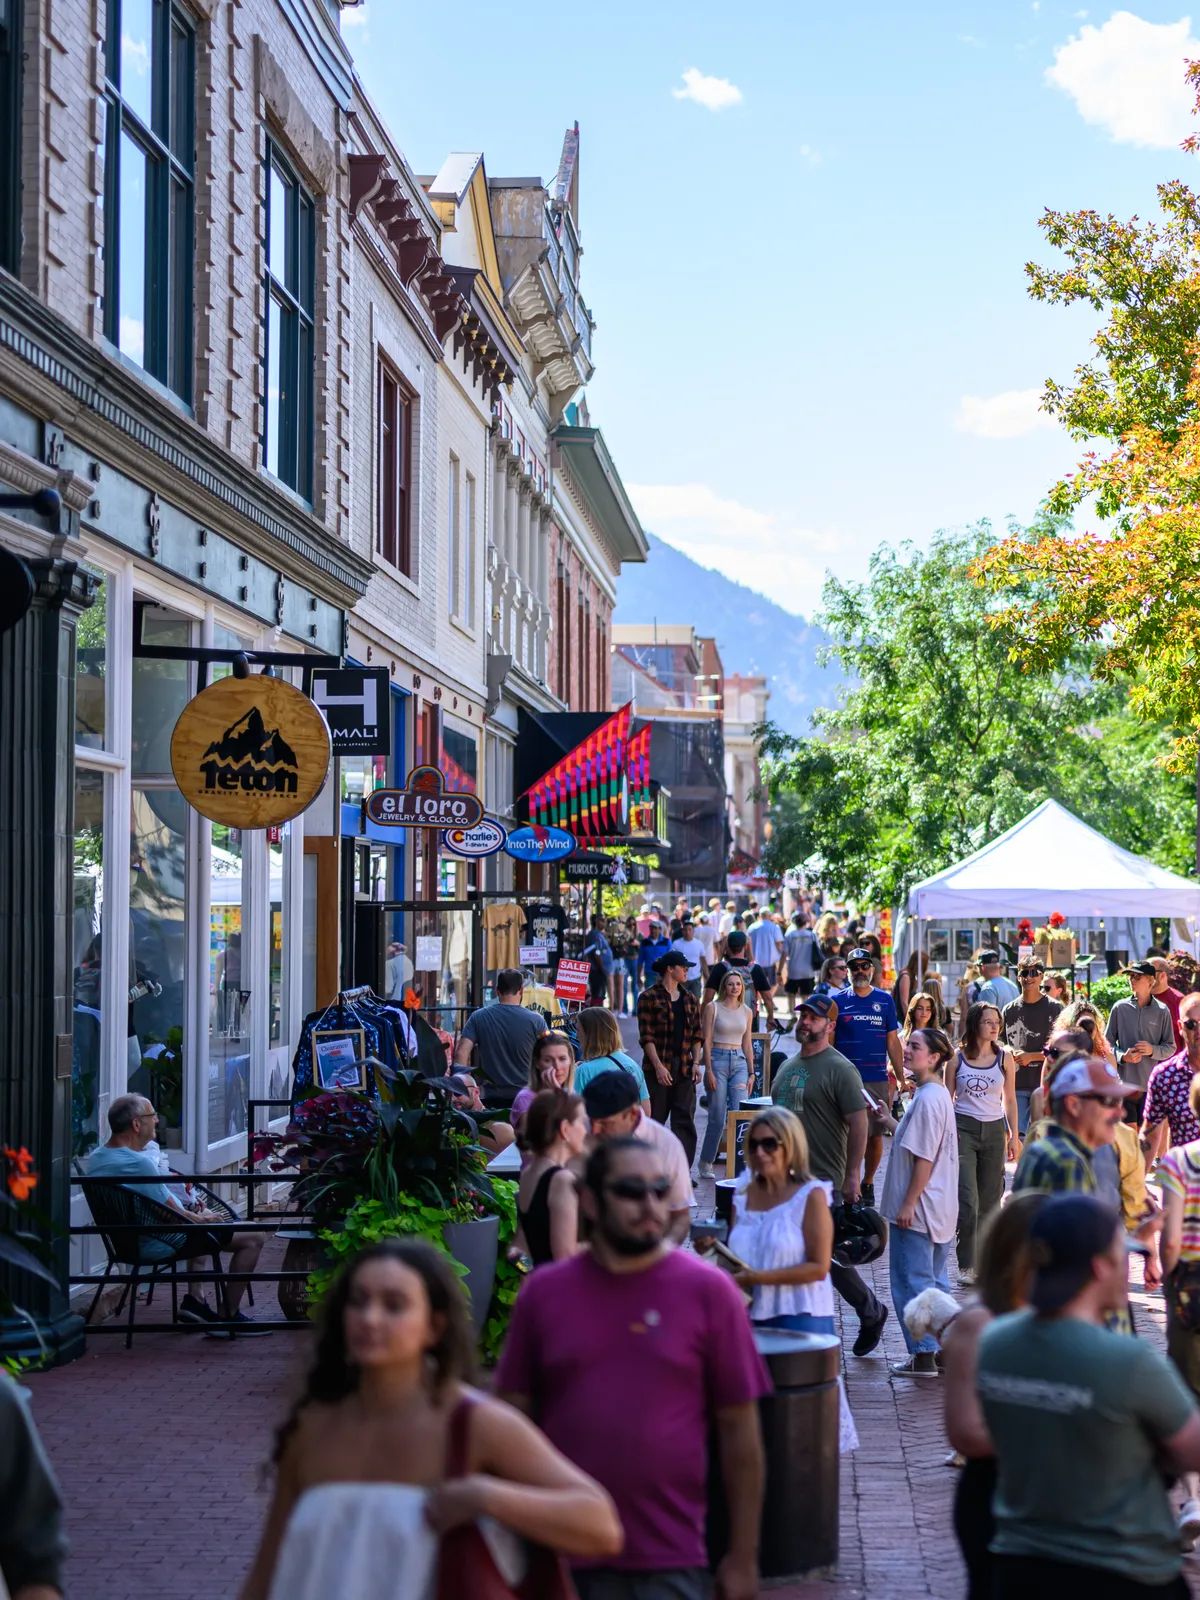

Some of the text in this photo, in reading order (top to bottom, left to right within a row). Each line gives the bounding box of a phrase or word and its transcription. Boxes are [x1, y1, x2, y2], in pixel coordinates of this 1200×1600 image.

[199, 760, 298, 792] Teton
[382, 795, 466, 817] el loro
[378, 813, 415, 821] JEWELRY
[418, 814, 425, 822] &
[428, 815, 453, 824] CLOG
[452, 831, 498, 844] Charlie's
[508, 839, 570, 849] Into The Wind
[560, 960, 589, 972] SALE!
